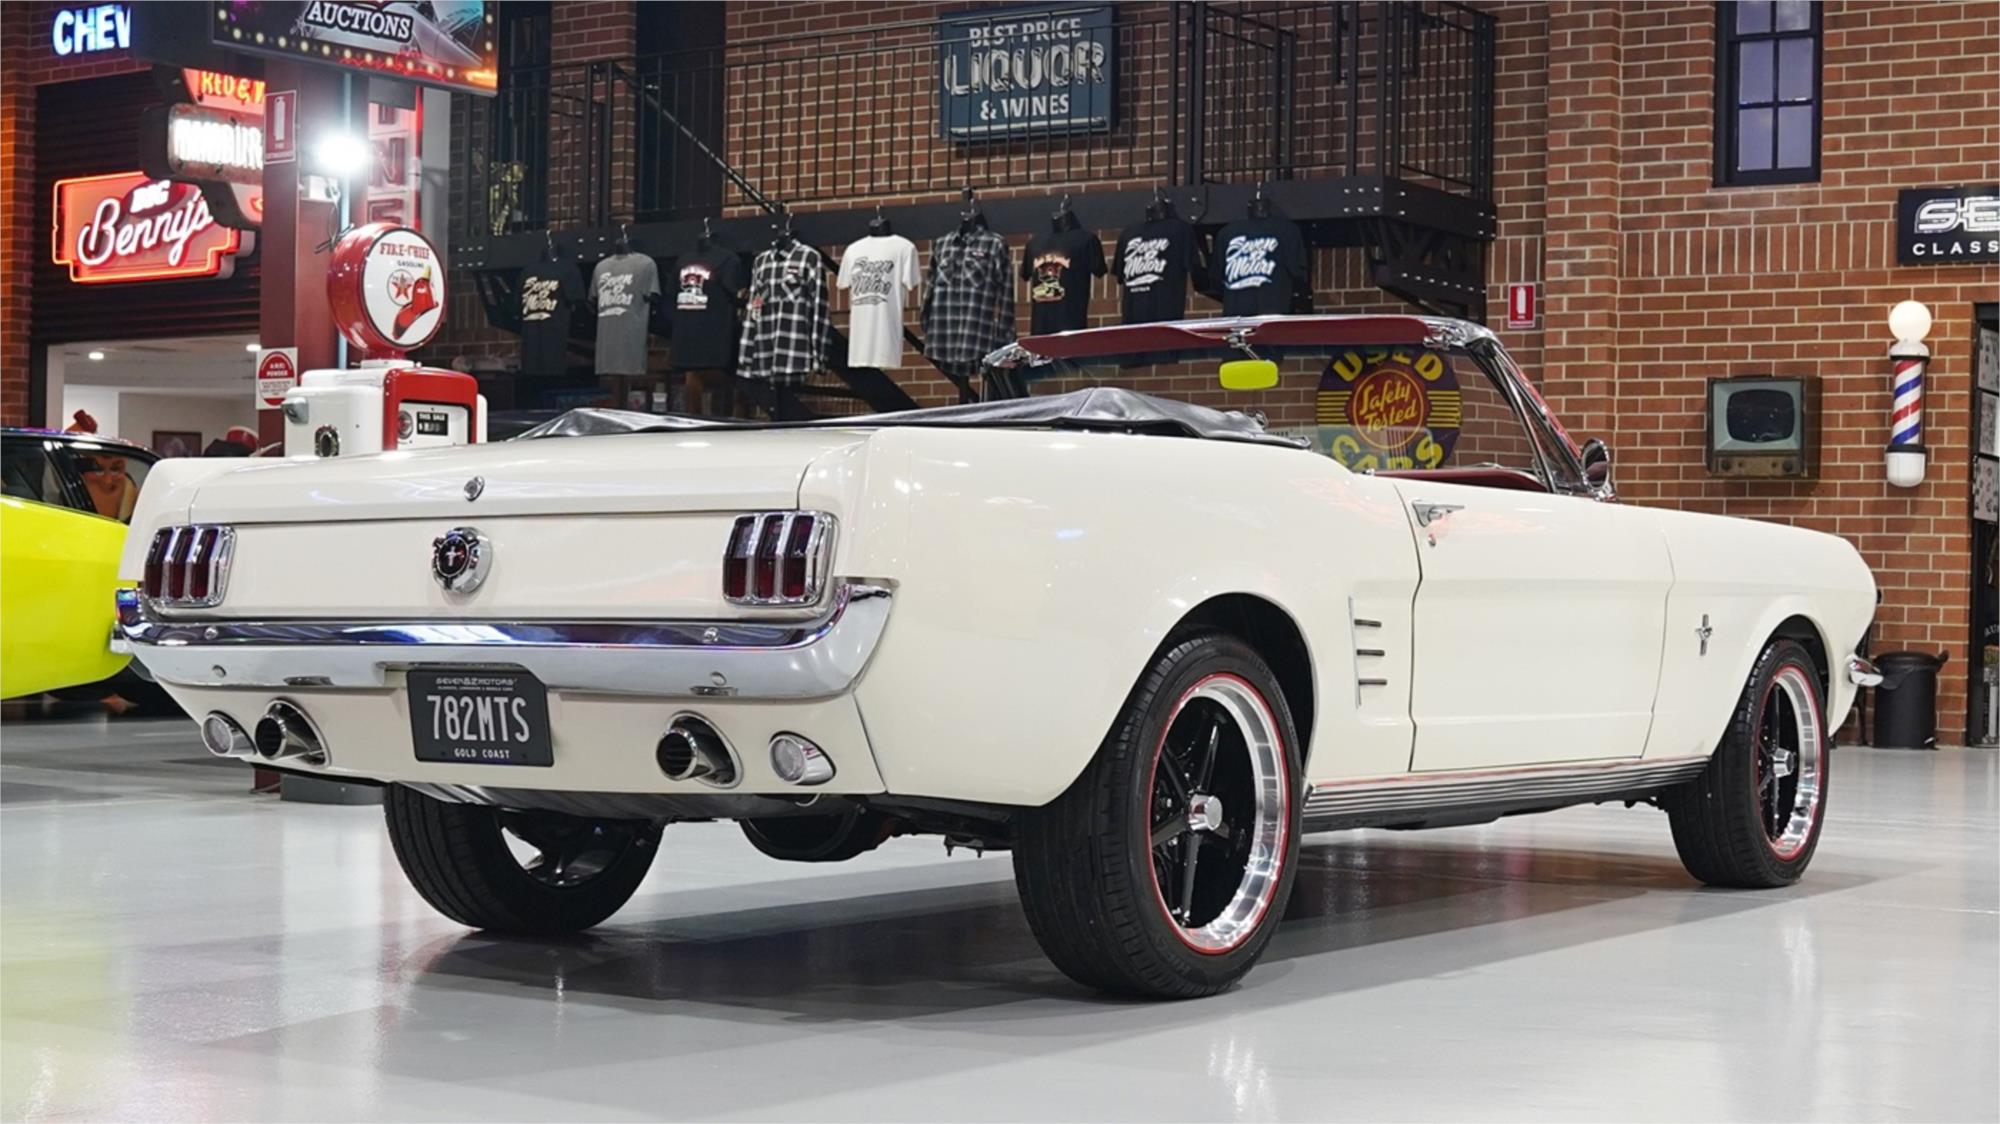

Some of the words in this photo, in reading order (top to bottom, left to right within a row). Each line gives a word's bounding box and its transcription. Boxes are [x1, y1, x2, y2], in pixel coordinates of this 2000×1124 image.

[53, 4, 132, 56] CHEV
[307, 1, 411, 39] AUCTIONS
[969, 25, 1018, 47] BEST
[1023, 18, 1081, 42] PRICE
[944, 41, 1104, 95] LIQUOR
[980, 100, 997, 120] &
[1002, 94, 1069, 118] WINES
[1333, 346, 1443, 381] USED
[1360, 379, 1411, 415] Safety
[1364, 399, 1418, 433] Tested
[427, 695, 530, 742] 782MTS
[454, 747, 477, 758] GOLD
[482, 749, 511, 759] COAST
